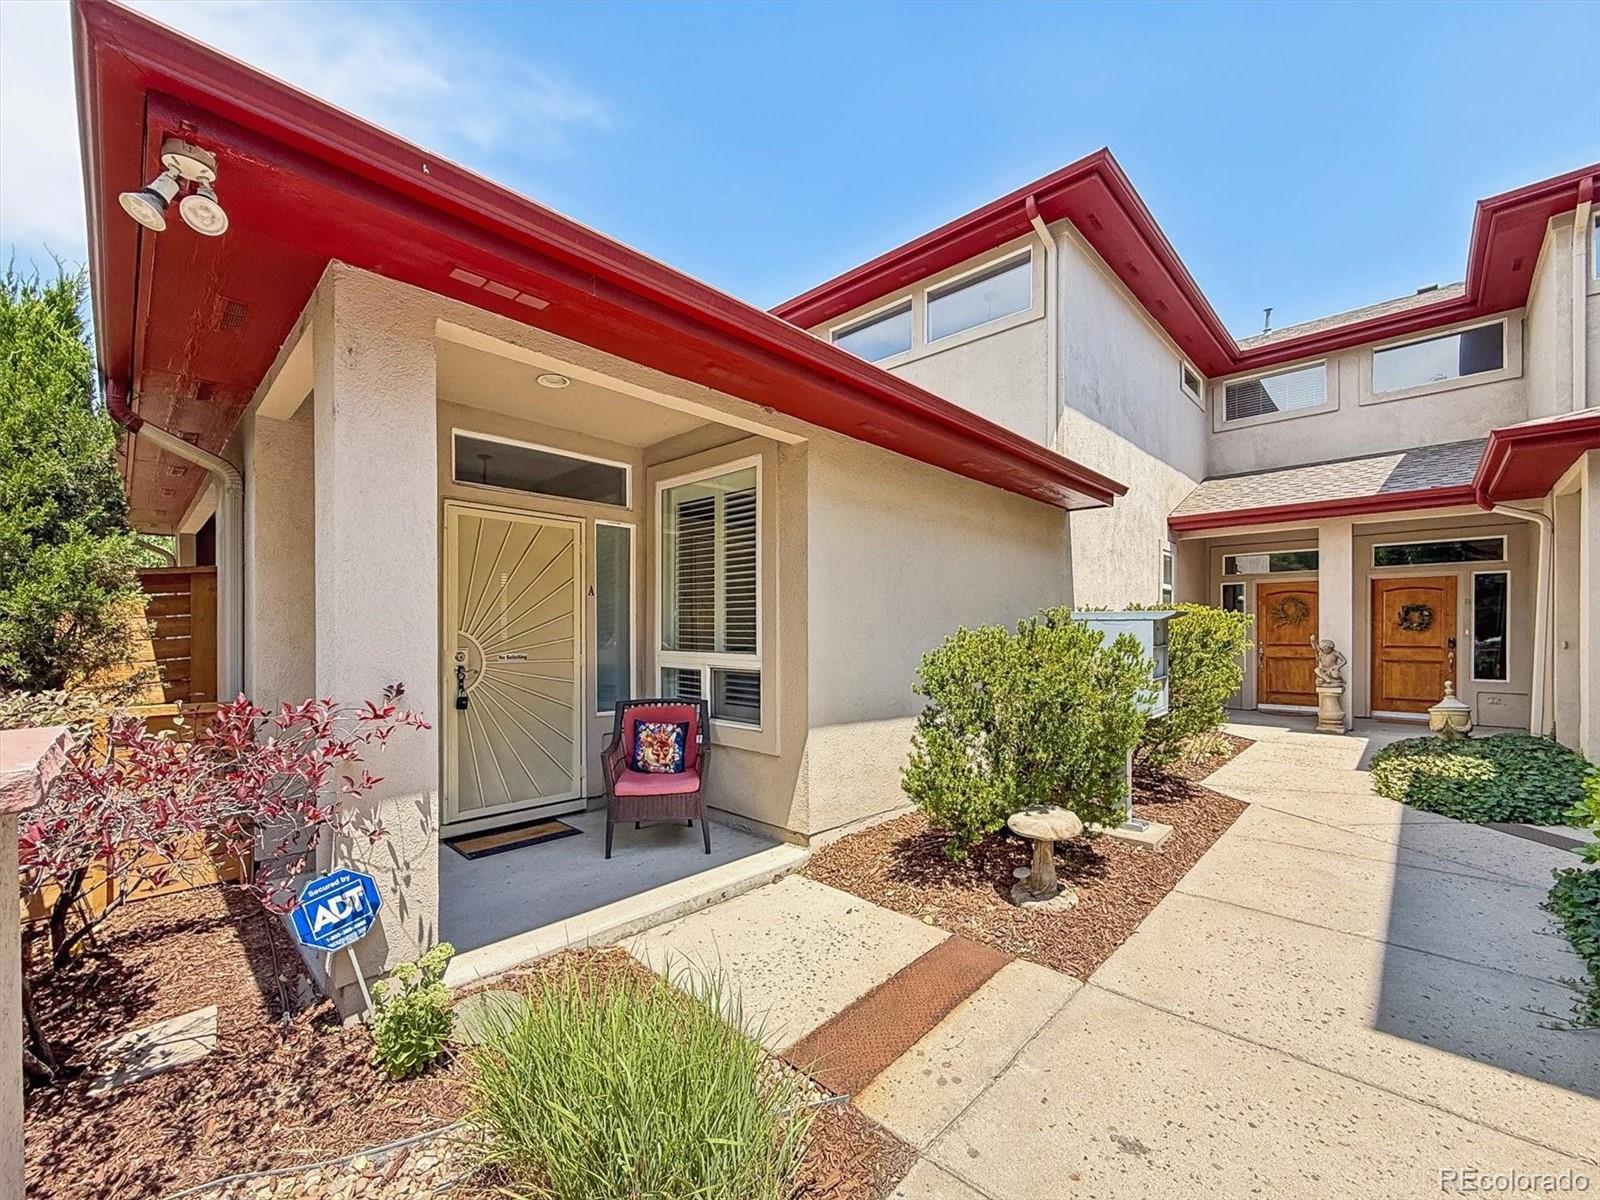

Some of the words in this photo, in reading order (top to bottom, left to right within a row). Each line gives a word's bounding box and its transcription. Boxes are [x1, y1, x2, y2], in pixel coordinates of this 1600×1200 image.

[588, 585, 595, 596] A
[308, 878, 340, 897] Secured
[313, 885, 364, 933] ADT
